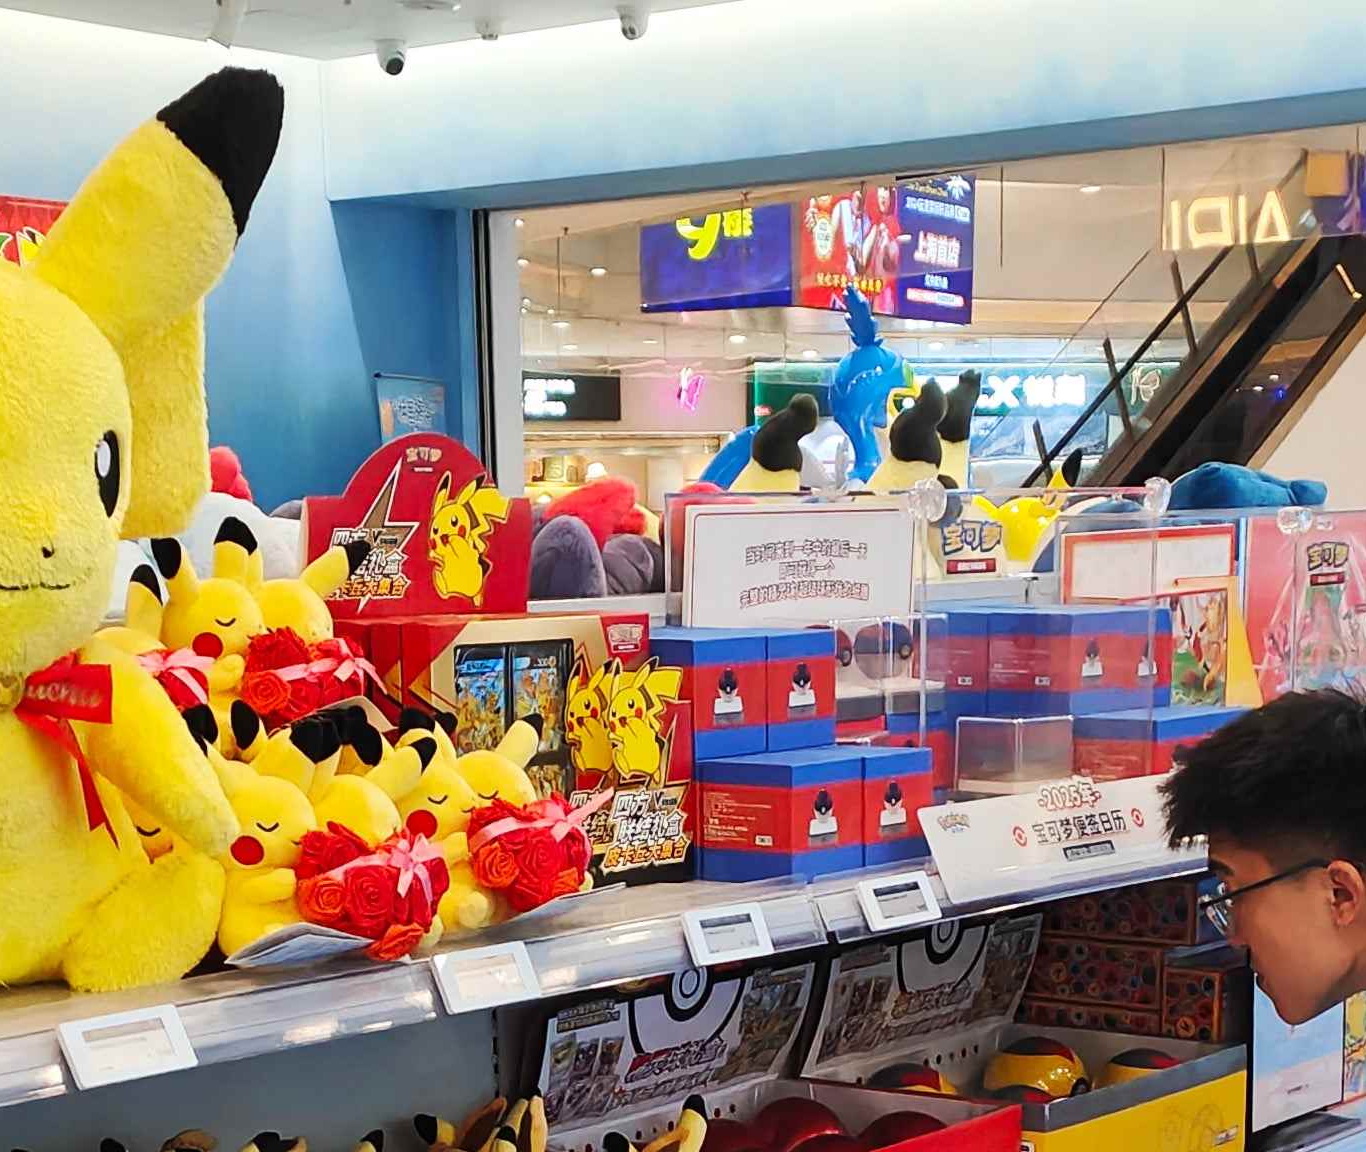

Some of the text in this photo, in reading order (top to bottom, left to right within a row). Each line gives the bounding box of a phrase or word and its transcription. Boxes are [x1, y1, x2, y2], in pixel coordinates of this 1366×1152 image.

[941, 520, 1003, 556] 宝可梦
[1042, 781, 1096, 811] 2025年
[1032, 808, 1128, 845] 宝可梦便签日历
